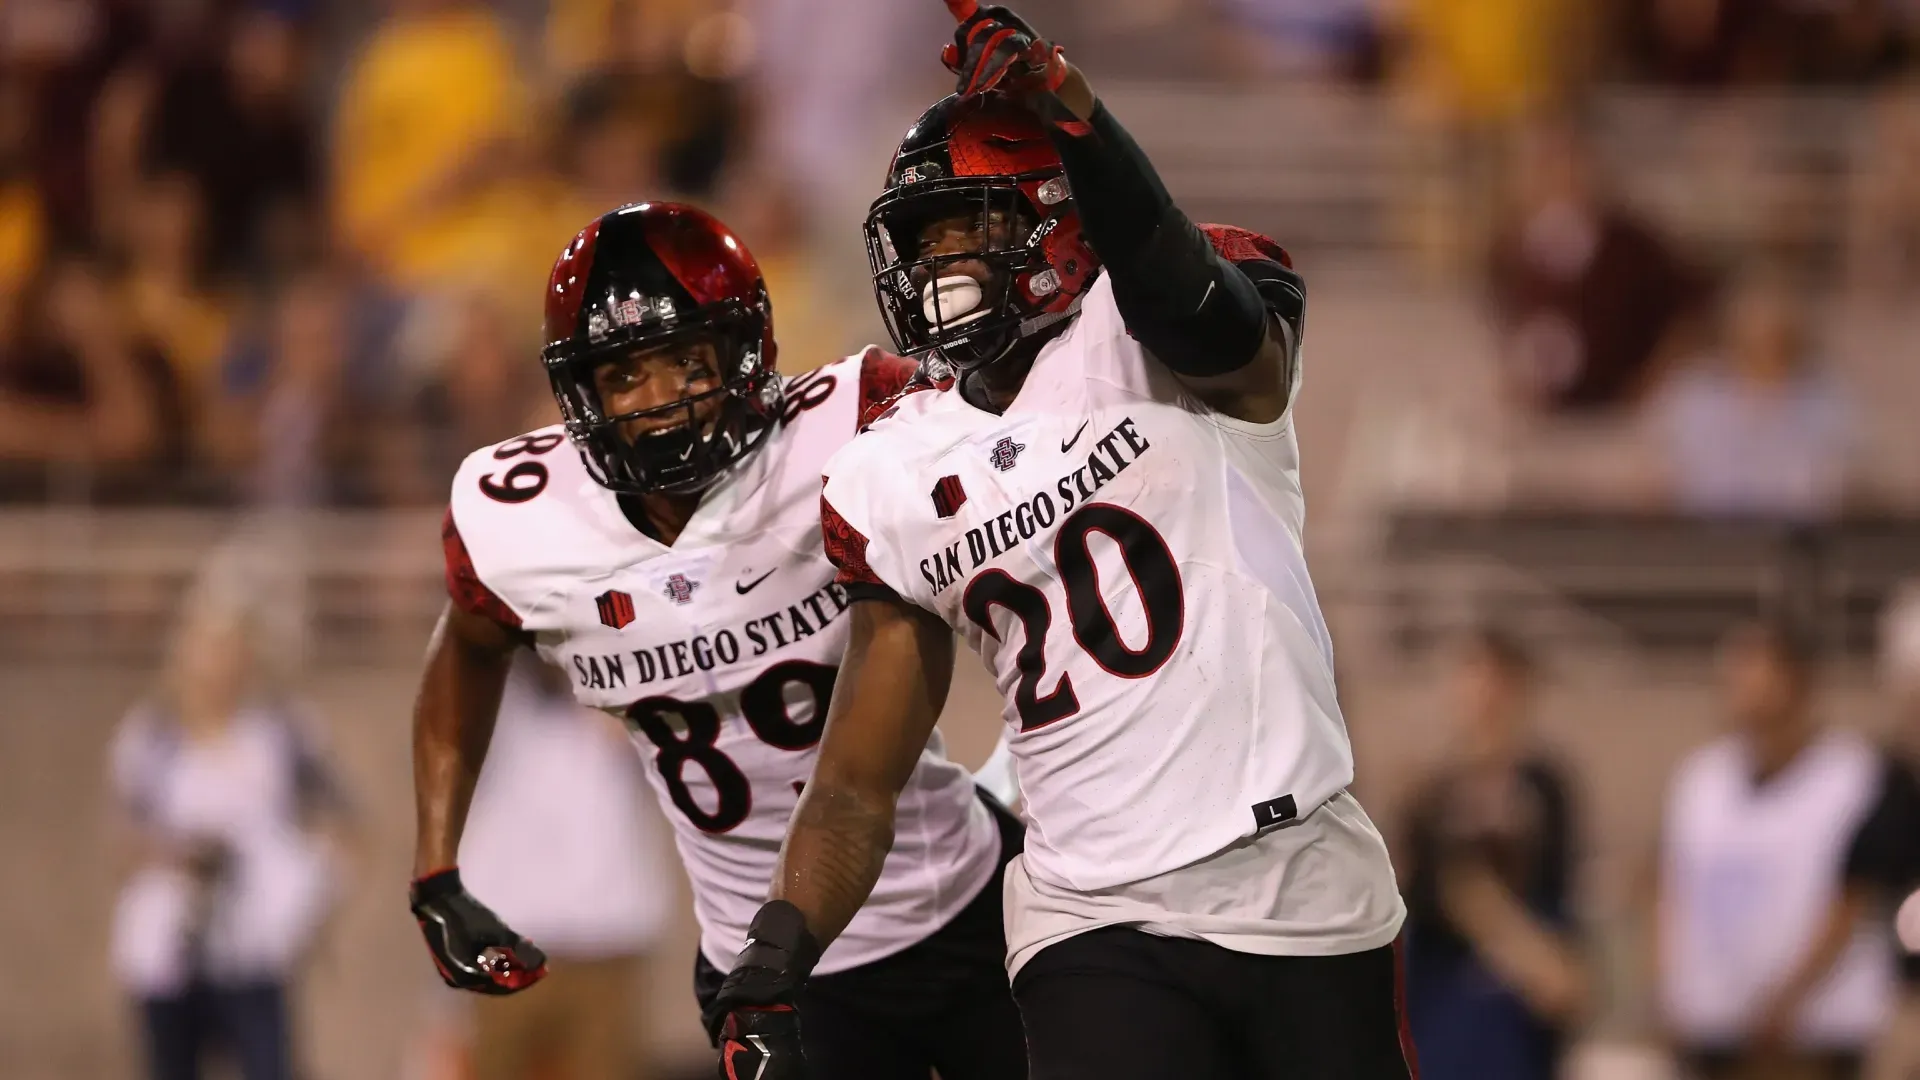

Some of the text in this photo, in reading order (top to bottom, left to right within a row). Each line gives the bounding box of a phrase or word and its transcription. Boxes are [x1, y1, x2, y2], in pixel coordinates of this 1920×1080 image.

[478, 434, 564, 504] 89
[920, 417, 1150, 596] SAN DIEGO STATE
[573, 583, 848, 689] SAN DIEGO STATE
[963, 502, 1185, 734] 20
[1269, 805, 1282, 819] L
